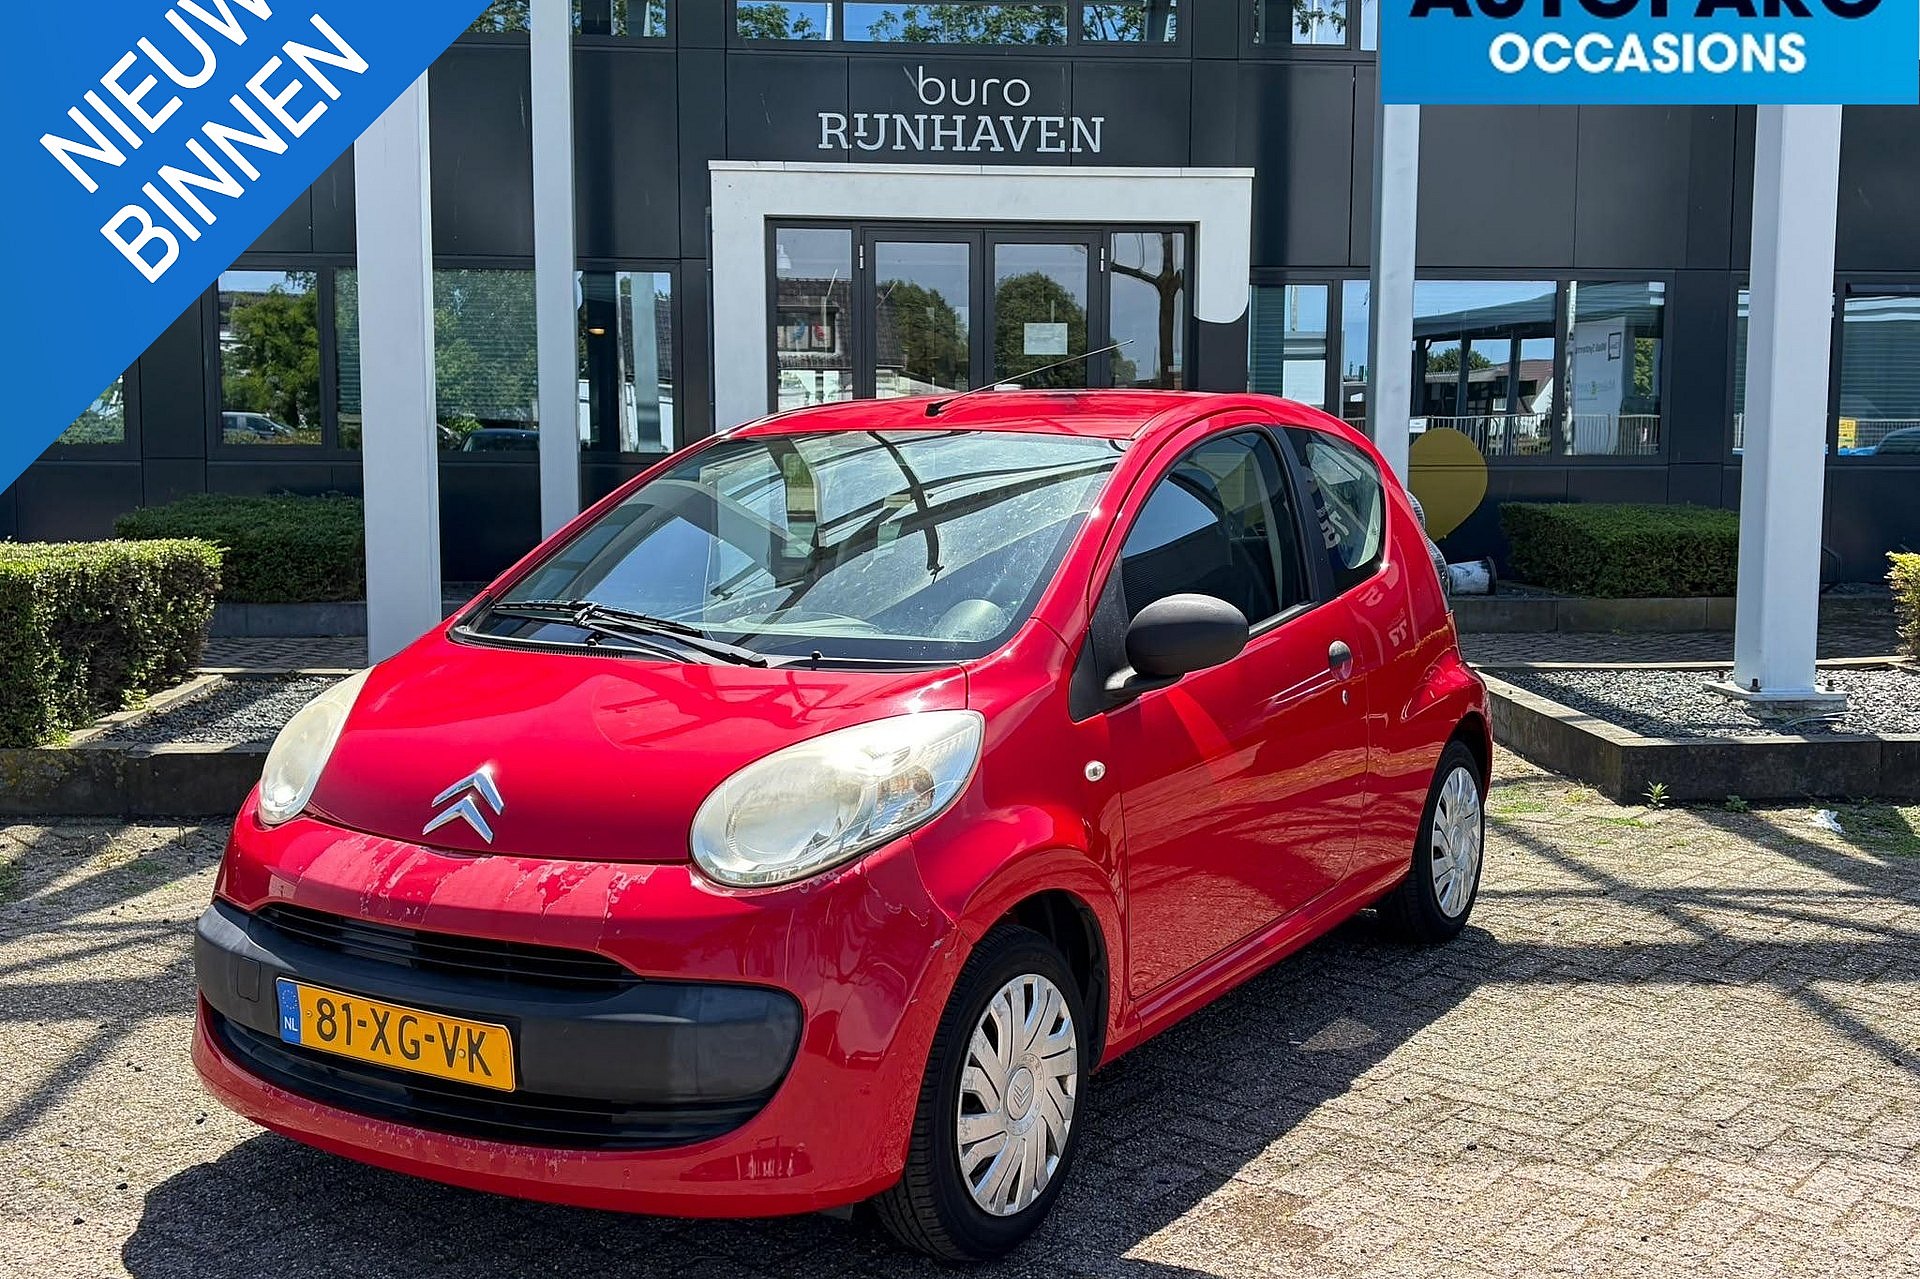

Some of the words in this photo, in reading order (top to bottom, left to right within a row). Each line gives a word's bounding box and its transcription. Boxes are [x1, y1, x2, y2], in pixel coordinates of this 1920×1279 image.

[918, 65, 1031, 107] buro
[818, 112, 1105, 153] RIJNHAVEN
[284, 1015, 299, 1032] NL
[316, 997, 492, 1077] 81-XG-VK
